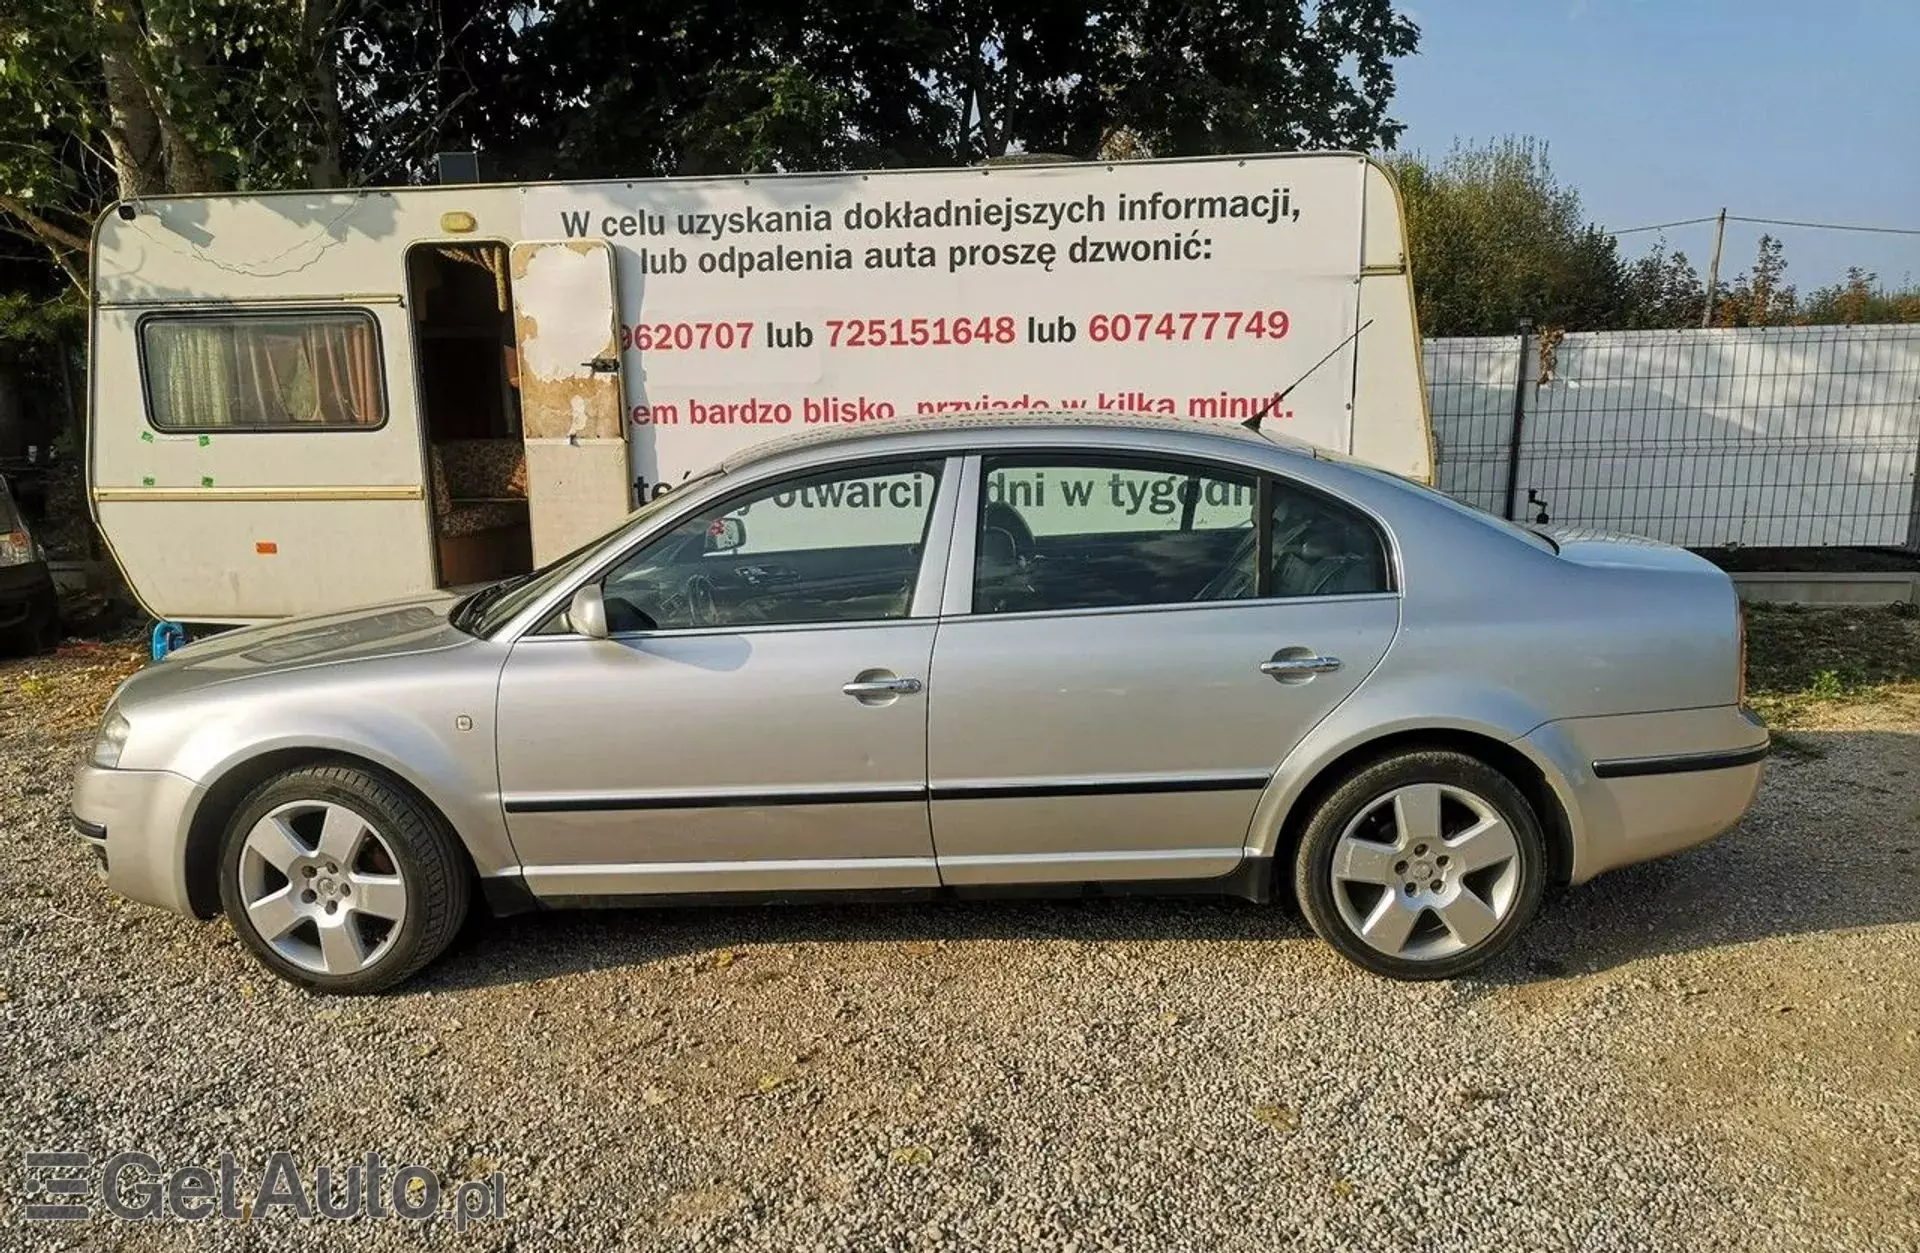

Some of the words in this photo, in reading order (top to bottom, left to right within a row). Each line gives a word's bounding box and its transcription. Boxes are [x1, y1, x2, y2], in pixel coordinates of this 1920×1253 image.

[560, 210, 591, 238] W
[601, 208, 666, 237] celu
[677, 203, 832, 241] uzyskania
[844, 194, 1105, 233] dokładniejszych
[1118, 187, 1301, 225] informacji,
[640, 247, 687, 275] lub
[698, 243, 853, 279] odpalenia
[864, 241, 936, 270] auta
[949, 241, 1057, 274] proszę
[1068, 228, 1213, 264] dzwonić:
[766, 321, 814, 349] lub
[826, 315, 1017, 348] 725151648
[1028, 315, 1077, 344] lub
[1087, 310, 1291, 343] 607477749
[627, 403, 679, 426] em
[689, 398, 793, 425] bardzo
[1098, 393, 1176, 414] kilka
[1188, 391, 1294, 419] minut.
[1060, 480, 1095, 507] w
